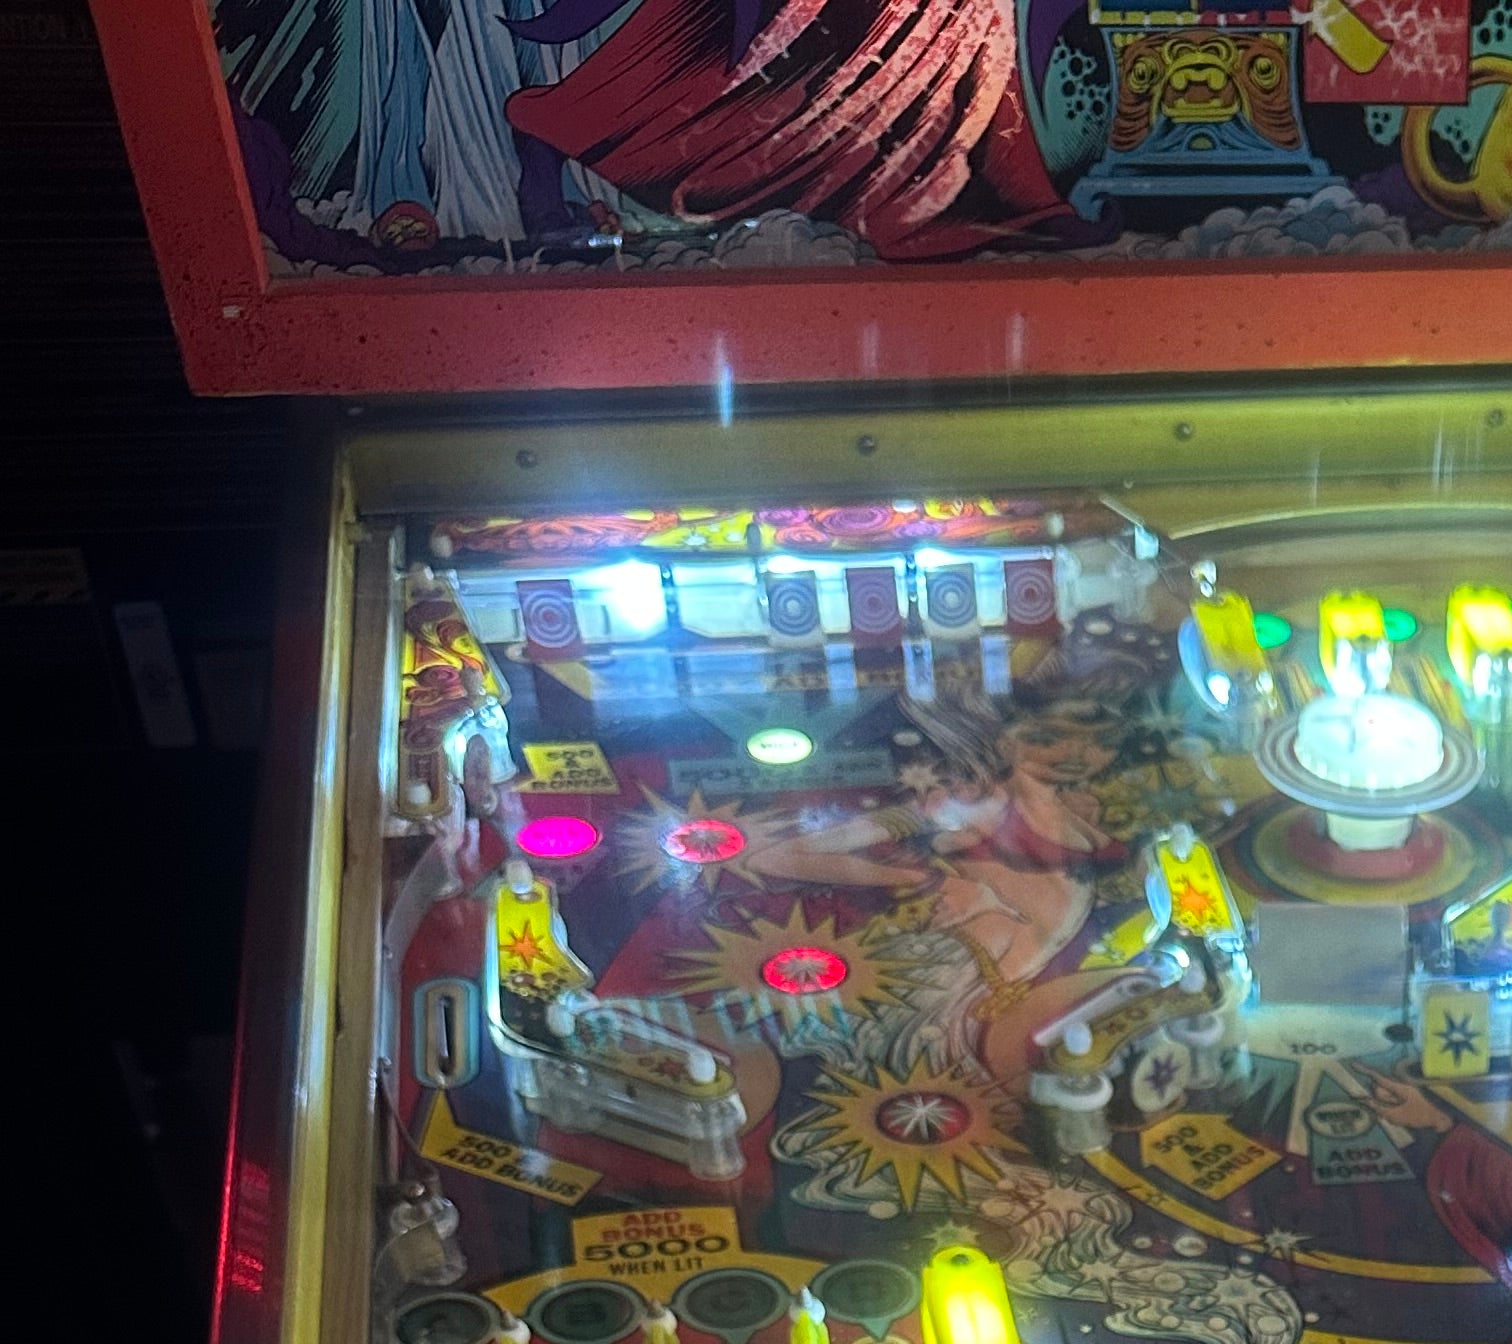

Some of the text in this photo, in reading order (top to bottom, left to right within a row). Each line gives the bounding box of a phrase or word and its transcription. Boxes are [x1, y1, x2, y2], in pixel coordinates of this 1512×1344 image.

[440, 1146, 496, 1176] ADD
[1190, 1142, 1234, 1171] ADD
[1328, 1149, 1383, 1163] ADD
[1192, 1145, 1266, 1190] BONUS
[1316, 1162, 1406, 1178] BONUS
[622, 1210, 682, 1228] ADD
[602, 1222, 706, 1244] BONUS
[582, 1235, 730, 1262] 5000
[608, 1256, 704, 1276] WHEN LIT
